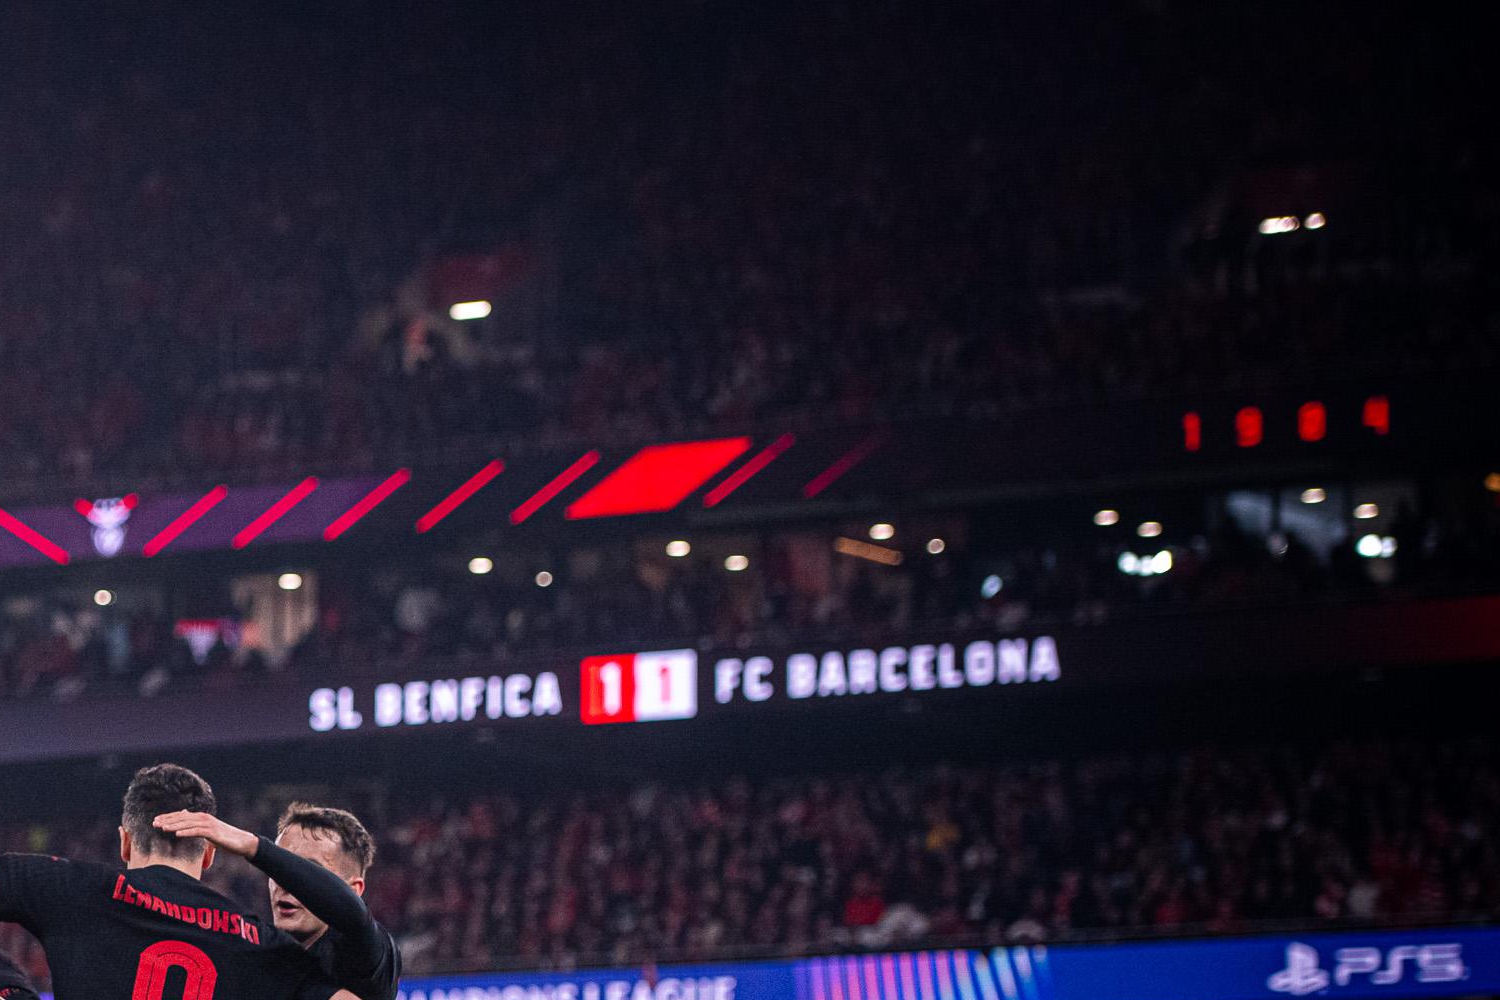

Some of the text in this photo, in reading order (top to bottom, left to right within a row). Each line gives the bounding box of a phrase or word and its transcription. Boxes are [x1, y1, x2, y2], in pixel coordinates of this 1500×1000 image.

[309, 686, 362, 731] SL
[375, 671, 562, 728] BENFICA
[600, 661, 623, 717] 1
[715, 656, 774, 704] FC
[786, 635, 1061, 699] BARCELONA
[112, 874, 260, 945] LEWANDOWSKI
[1334, 943, 1464, 986] PS5
